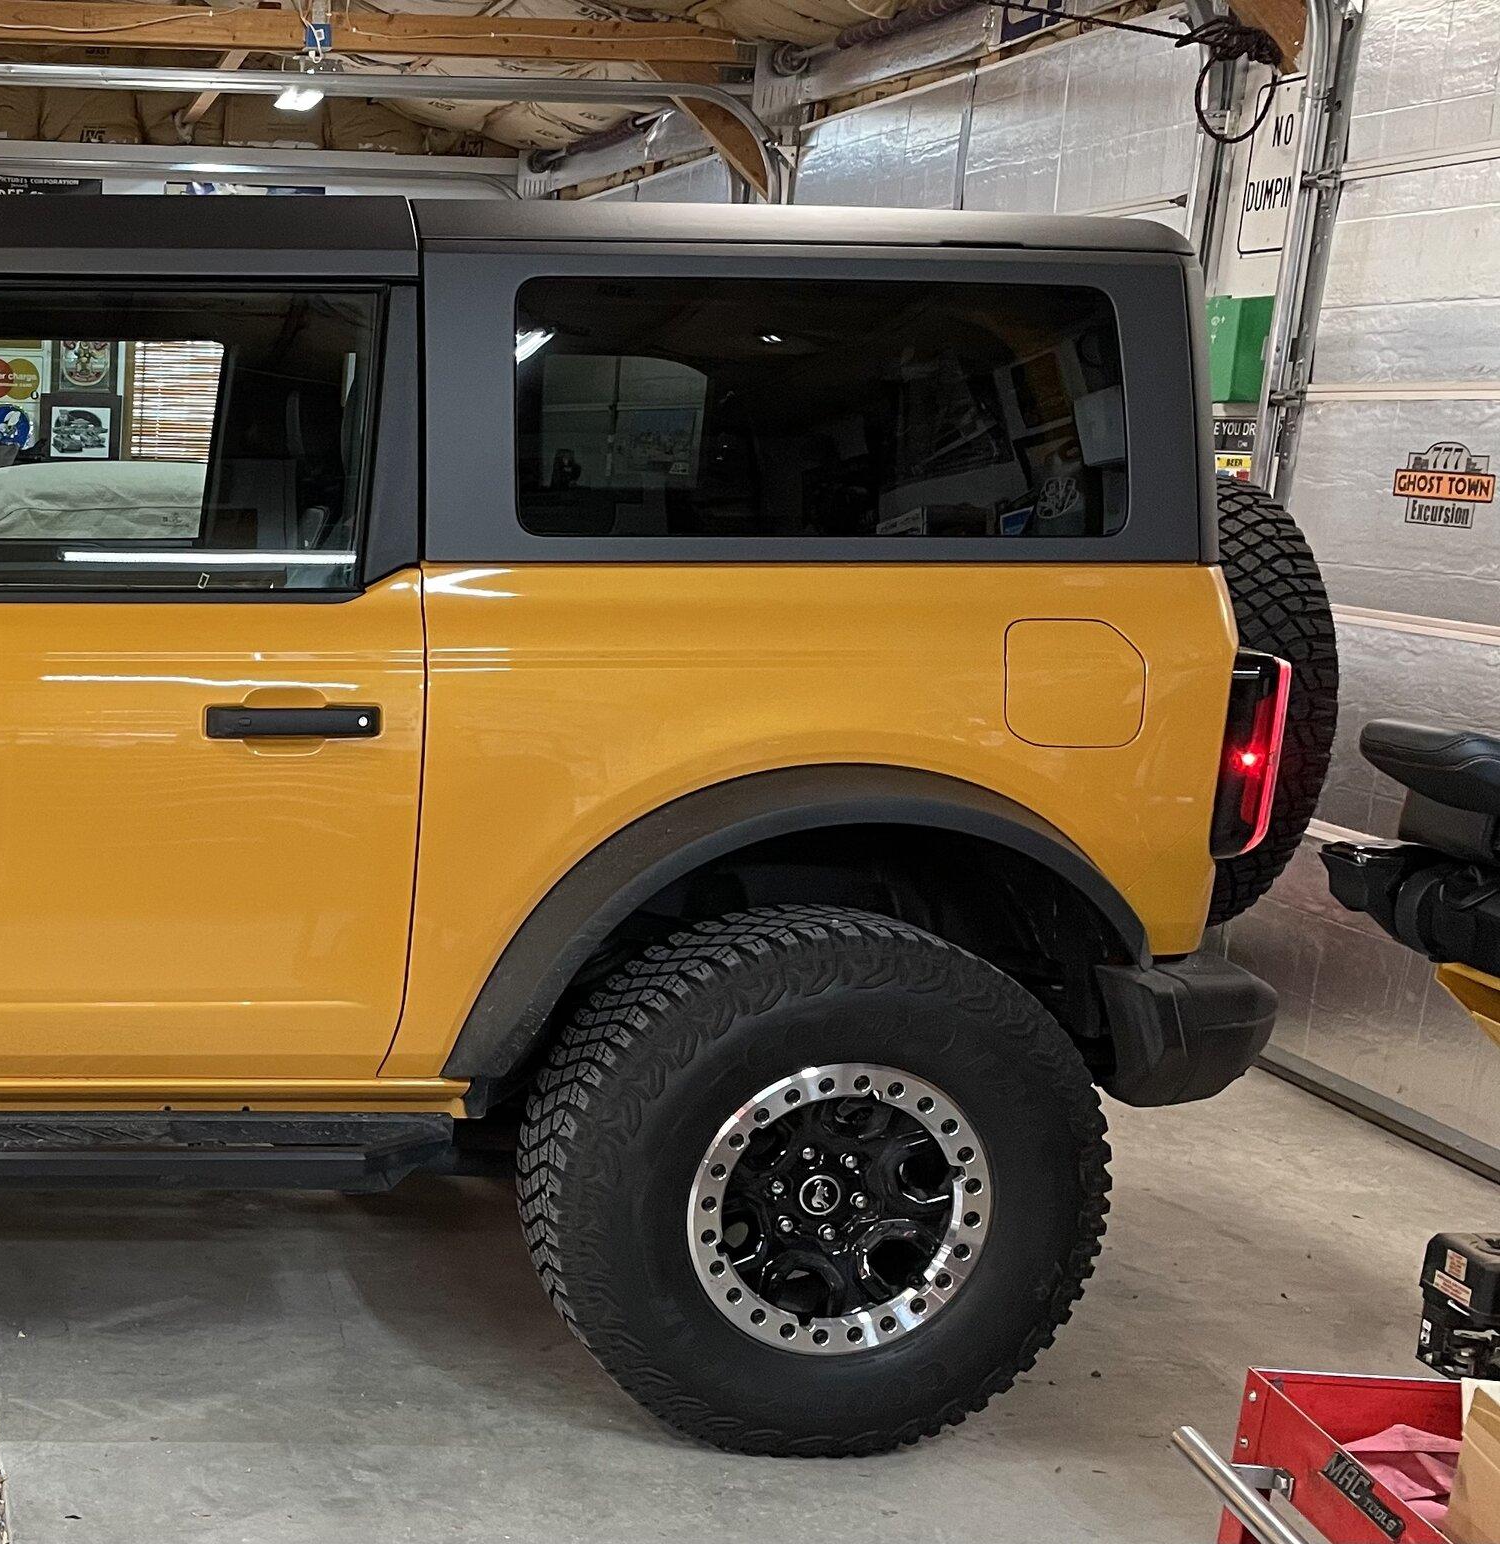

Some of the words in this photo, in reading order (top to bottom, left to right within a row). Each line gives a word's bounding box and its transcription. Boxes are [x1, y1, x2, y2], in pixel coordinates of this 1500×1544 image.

[1272, 113, 1294, 147] NO
[30, 178, 79, 186] CORPORATION
[1245, 176, 1292, 212] DUMPIN
[8, 372, 38, 382] charge
[1222, 422, 1240, 435] YOU
[1226, 458, 1244, 467] BEER
[1429, 446, 1465, 471] 777
[1397, 473, 1444, 494] GHOST
[1447, 477, 1492, 498] TOWN
[1410, 499, 1471, 527] Excursion
[1323, 1451, 1371, 1499] MAC
[1363, 1500, 1397, 1531] TOOLS
